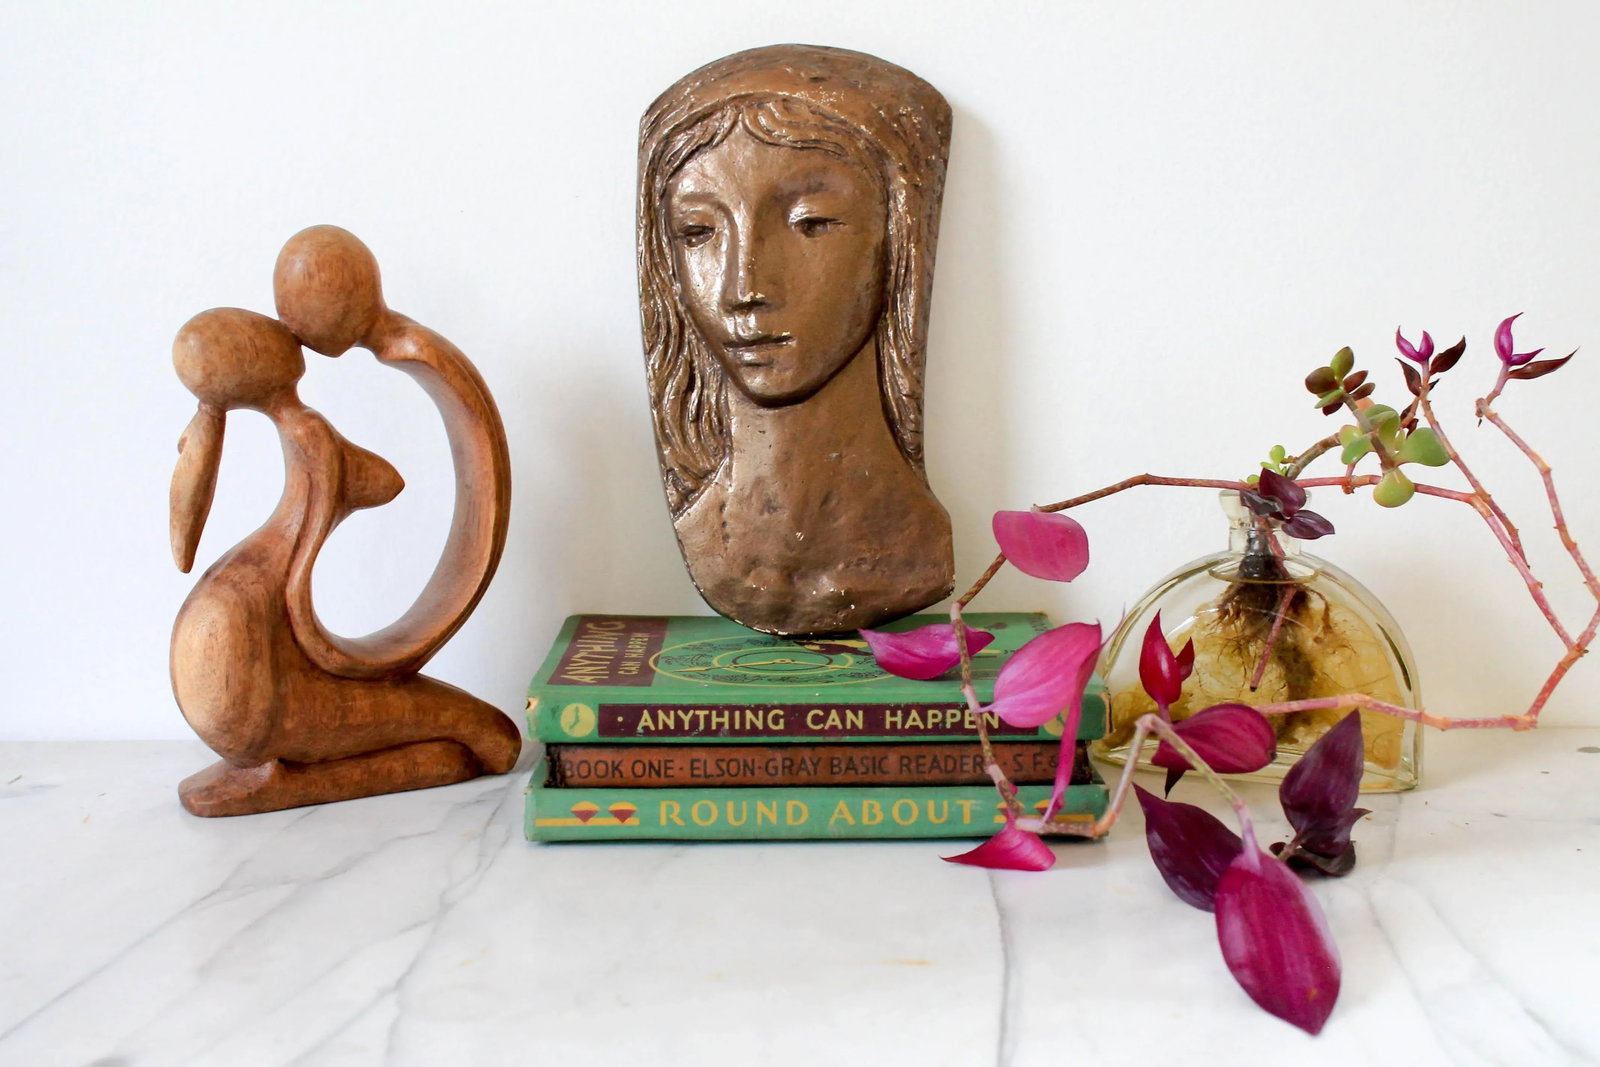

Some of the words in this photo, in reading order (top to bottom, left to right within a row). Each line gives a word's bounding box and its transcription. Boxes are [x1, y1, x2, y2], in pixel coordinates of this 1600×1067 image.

[560, 621, 626, 683] ANYTHING
[624, 632, 650, 658] HAPPEN
[618, 661, 641, 675] CAN
[637, 709, 785, 731] ANYTHING
[806, 709, 864, 730] CAN
[885, 708, 999, 730] HAPPEN
[566, 759, 624, 779] BOOK
[631, 759, 675, 779] ONE
[830, 755, 892, 776] BASIC
[899, 753, 995, 775] READER
[659, 799, 809, 826] ROUND
[829, 798, 977, 826] ABOUT
